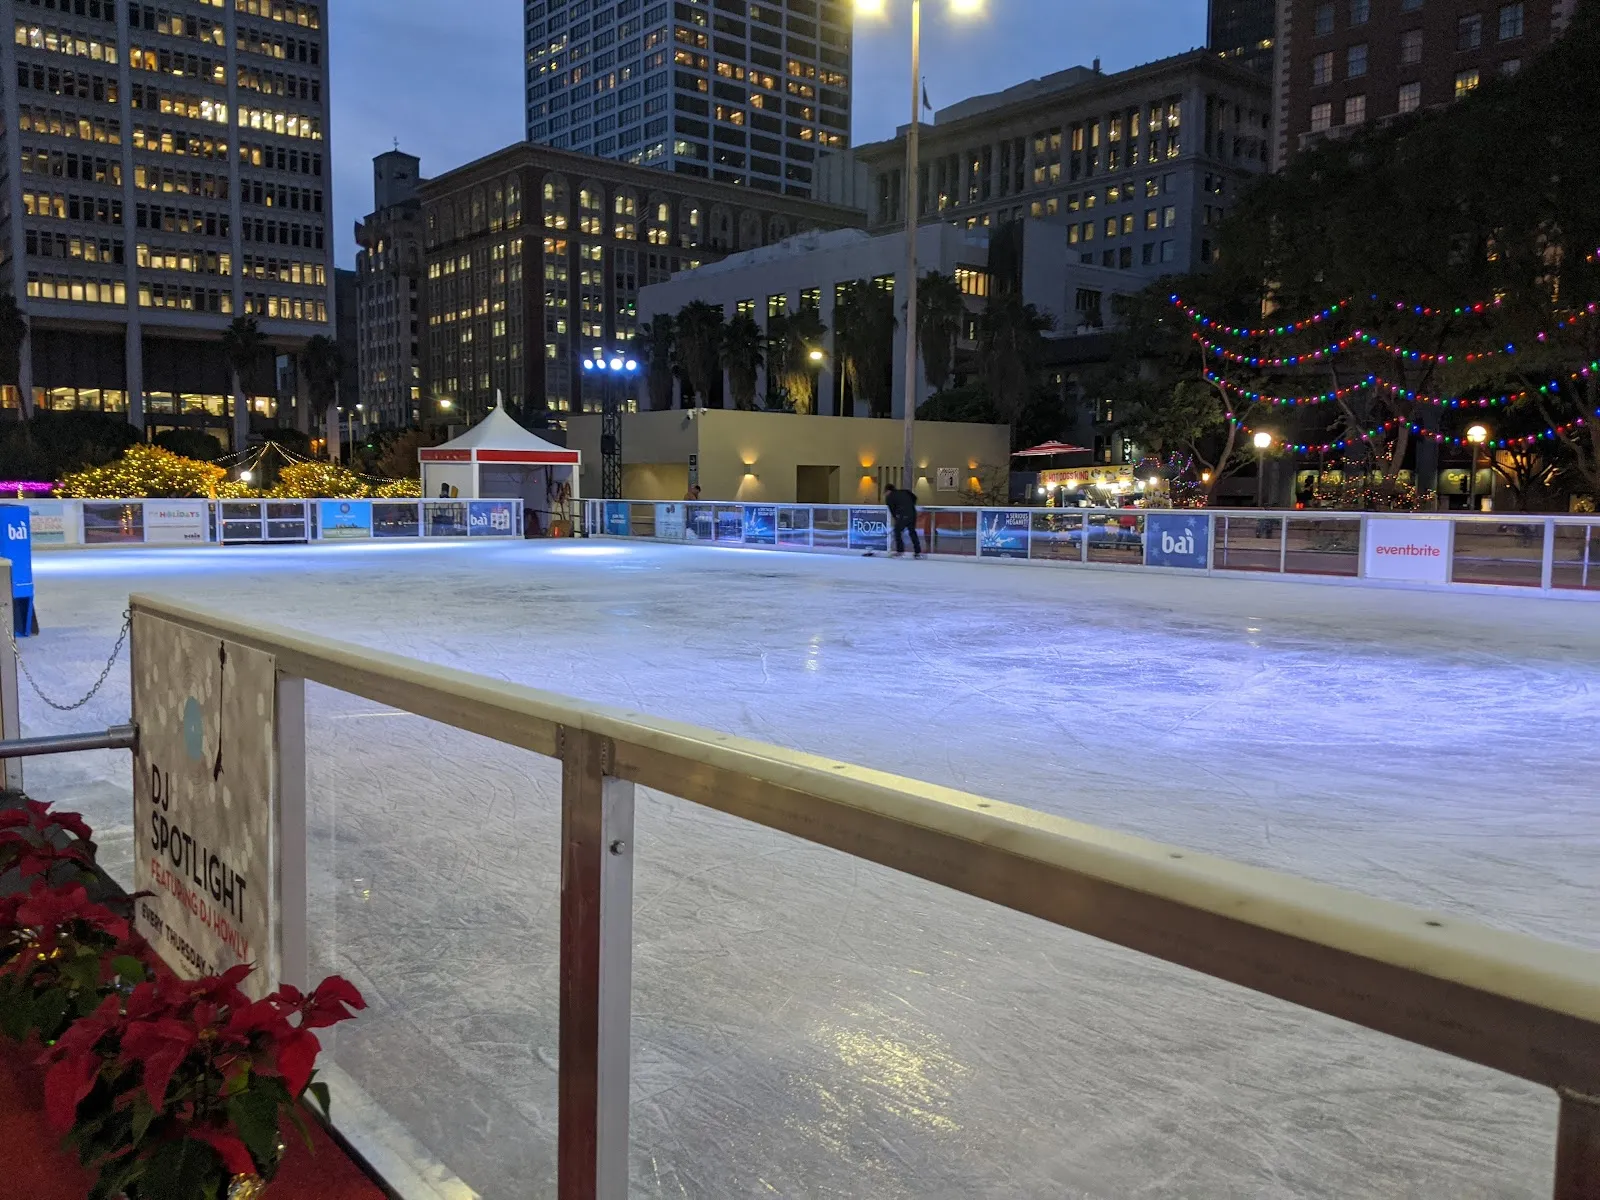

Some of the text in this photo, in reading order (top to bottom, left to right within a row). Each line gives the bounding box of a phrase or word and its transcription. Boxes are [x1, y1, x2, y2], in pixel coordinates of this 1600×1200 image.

[852, 517, 888, 536] FROZEN
[1161, 527, 1195, 554] bai
[1376, 543, 1441, 557] eventbrite
[151, 763, 169, 812] DJ
[151, 810, 247, 924] SPOTLIGHT
[151, 857, 248, 963] FEATURING DJ HOWLY
[165, 923, 206, 975] THURSDAY
